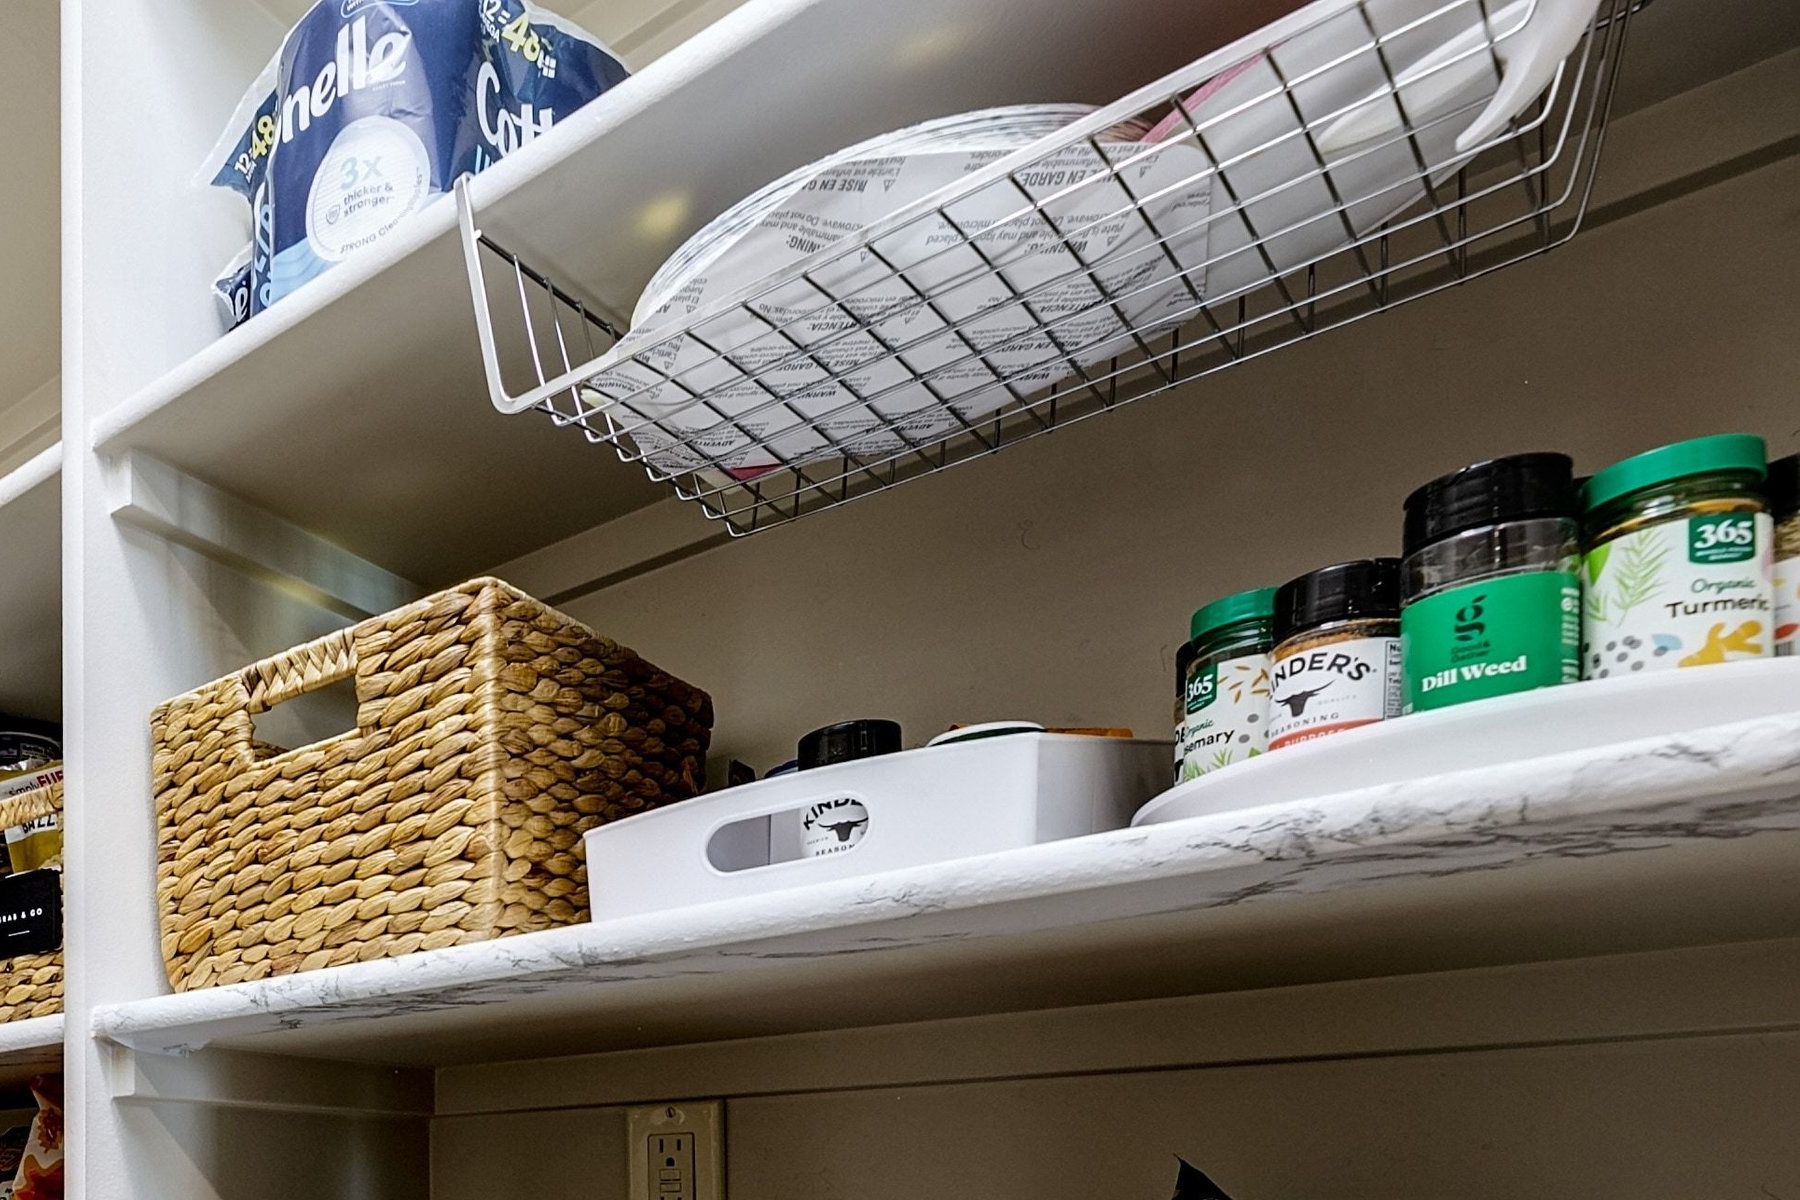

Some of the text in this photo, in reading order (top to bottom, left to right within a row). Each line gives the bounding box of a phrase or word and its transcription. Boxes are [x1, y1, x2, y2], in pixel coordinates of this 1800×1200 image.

[1693, 518, 1754, 550] 365
[1691, 577, 1757, 595] Organic
[1664, 593, 1770, 619] Turmeric
[1186, 673, 1214, 702] 365
[1269, 651, 1371, 700] INDER'S
[1421, 655, 1528, 693] Dill Weed
